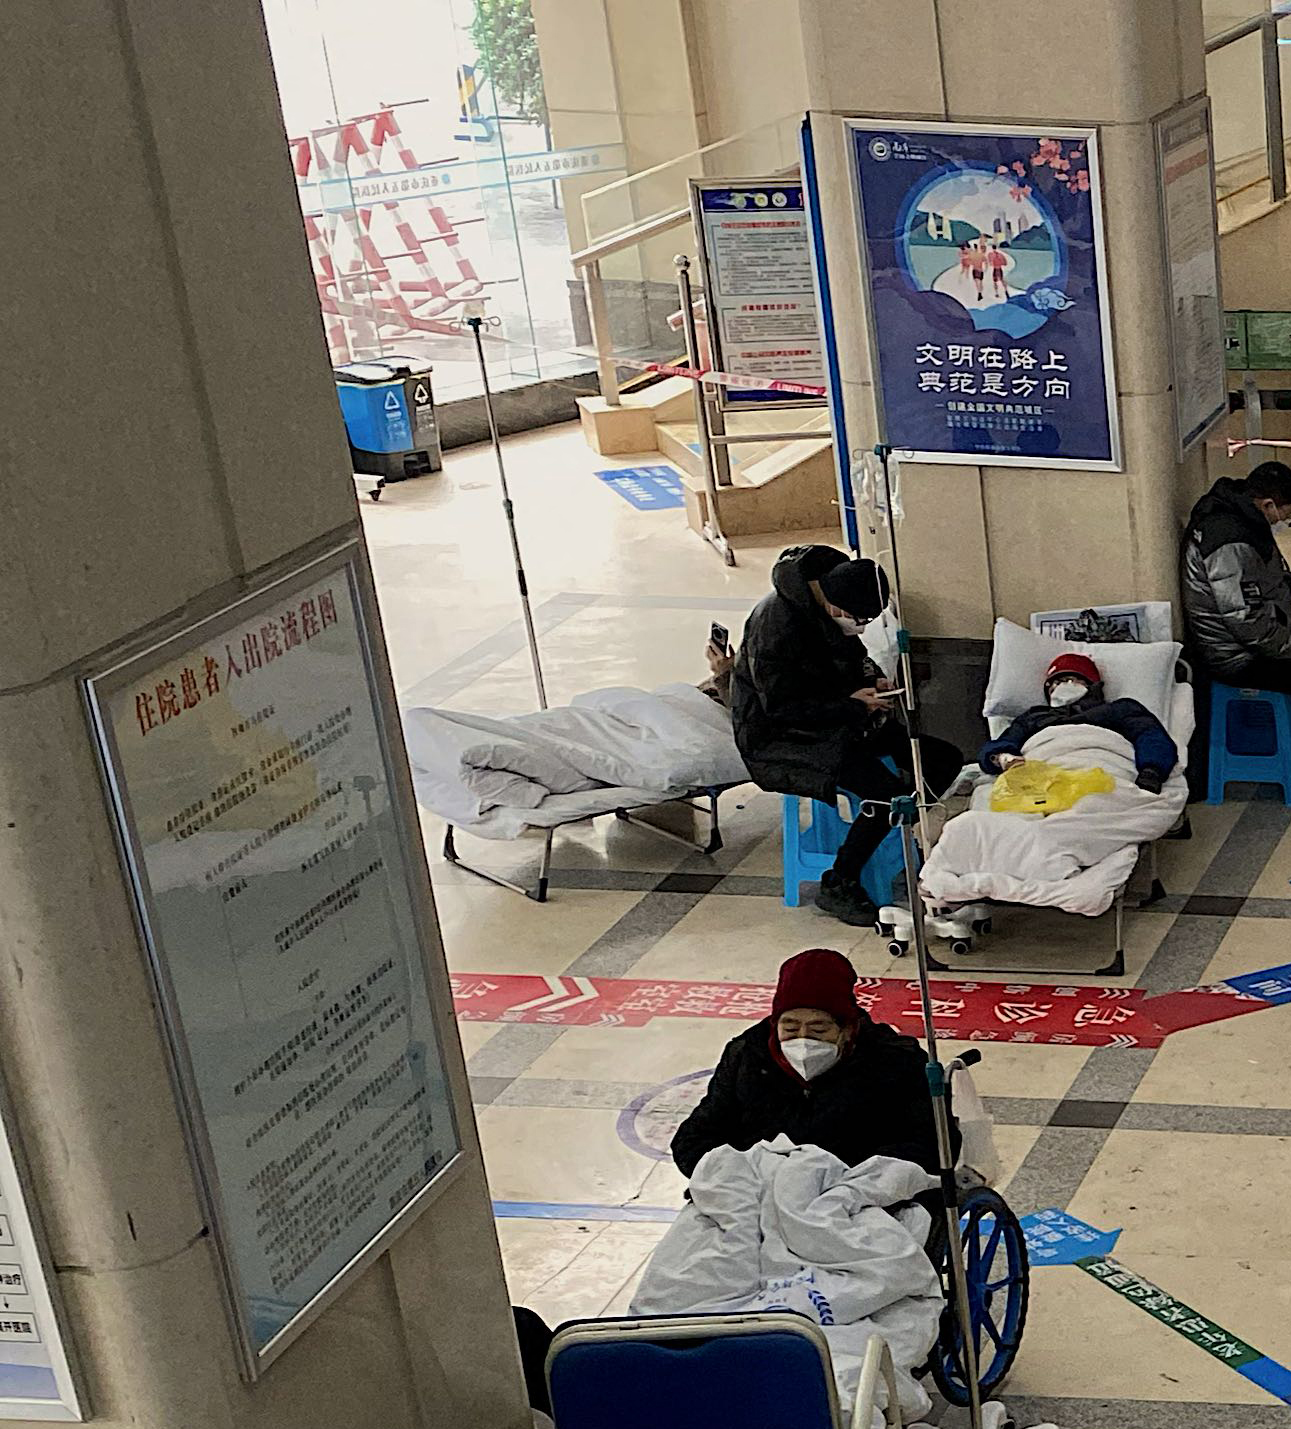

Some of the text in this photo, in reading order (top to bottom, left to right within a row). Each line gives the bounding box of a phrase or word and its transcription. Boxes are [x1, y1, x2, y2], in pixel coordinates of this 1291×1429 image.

[914, 342, 1069, 373] 文明在路上
[917, 371, 1071, 400] 典范是方向
[135, 588, 338, 737] 住院患者入出院流程图
[901, 998, 1137, 1028] 急诊科
